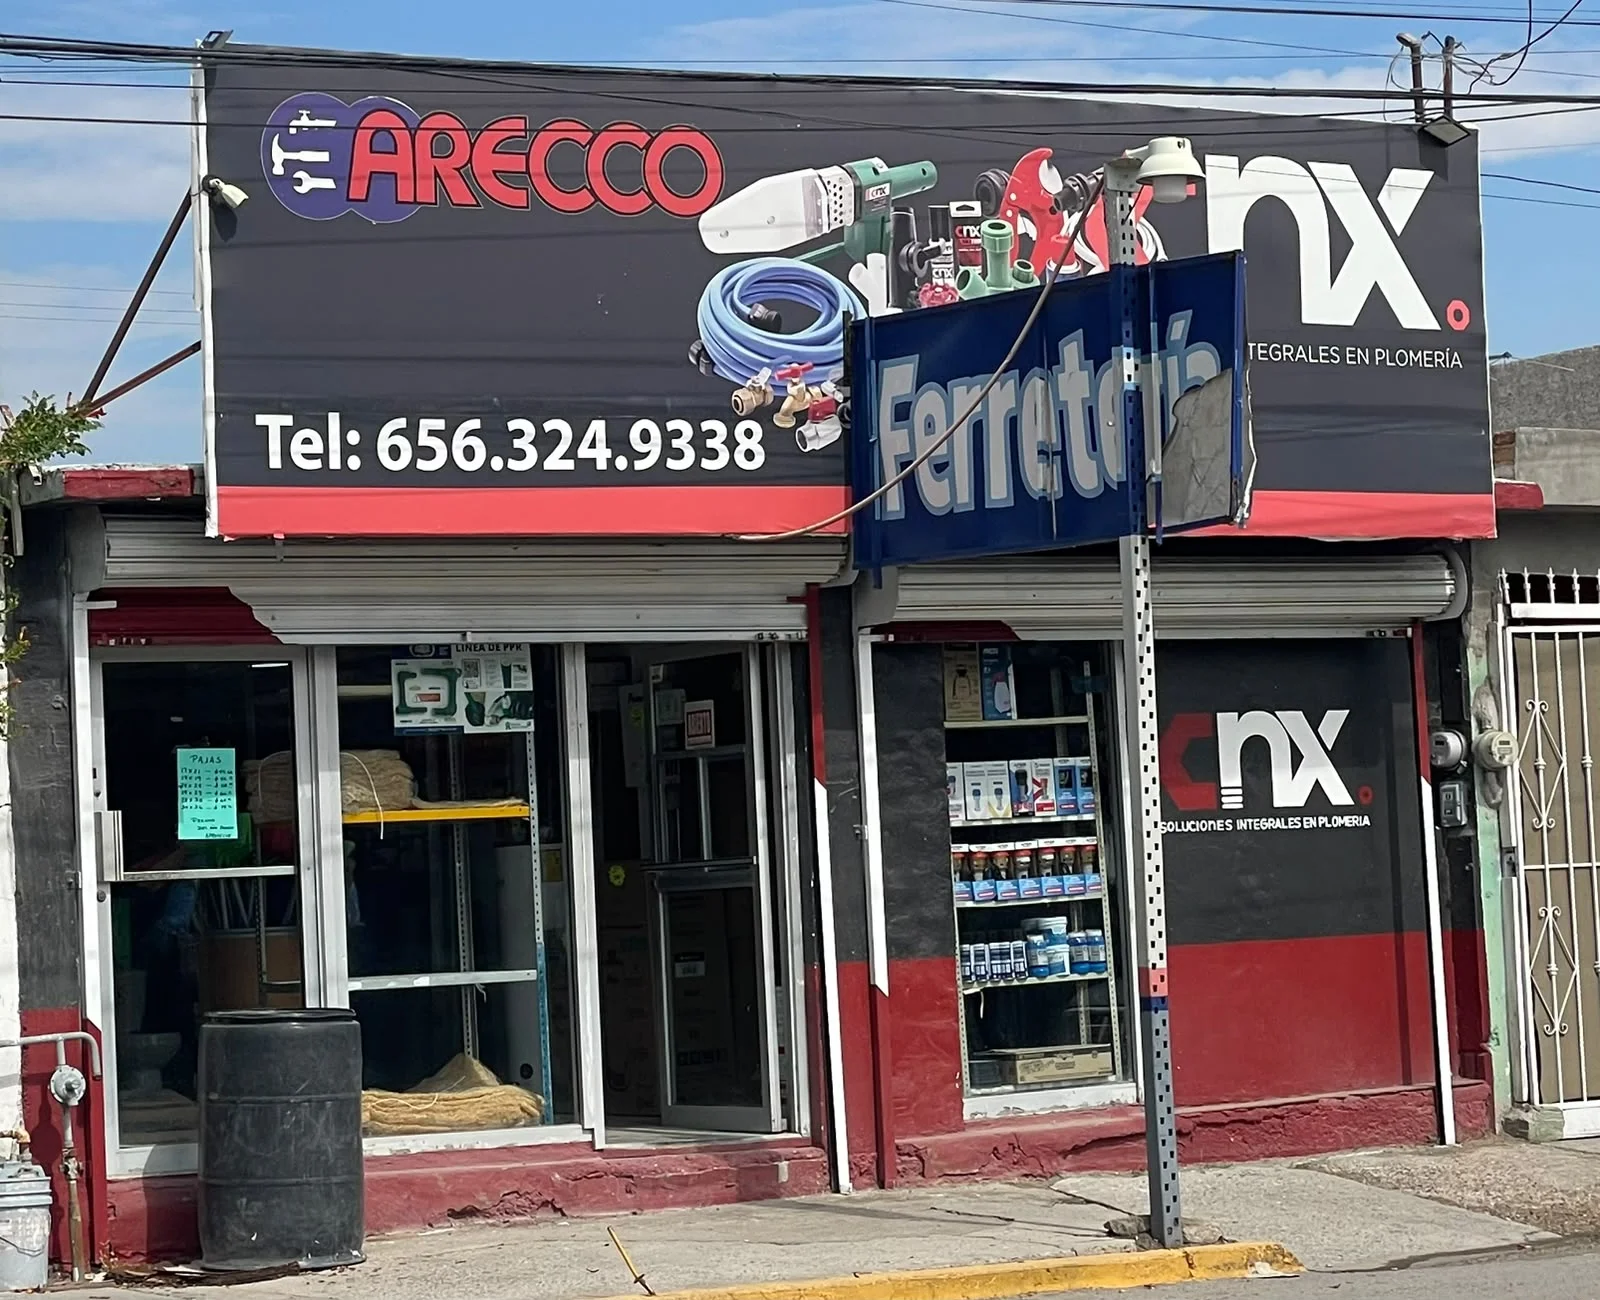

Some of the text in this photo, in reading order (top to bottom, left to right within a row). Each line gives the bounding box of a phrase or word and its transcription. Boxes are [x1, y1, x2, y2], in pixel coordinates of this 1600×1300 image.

[345, 108, 725, 219] ARECCO
[1346, 347, 1369, 365] EN
[1375, 348, 1463, 369] PLOMERÍA
[255, 412, 766, 472] Tel: 656.324.9338
[190, 754, 222, 764] PAJAS
[1236, 816, 1302, 831] INTEGRALES
[1302, 816, 1317, 829] EN
[1318, 815, 1371, 828] PLOMERIA
